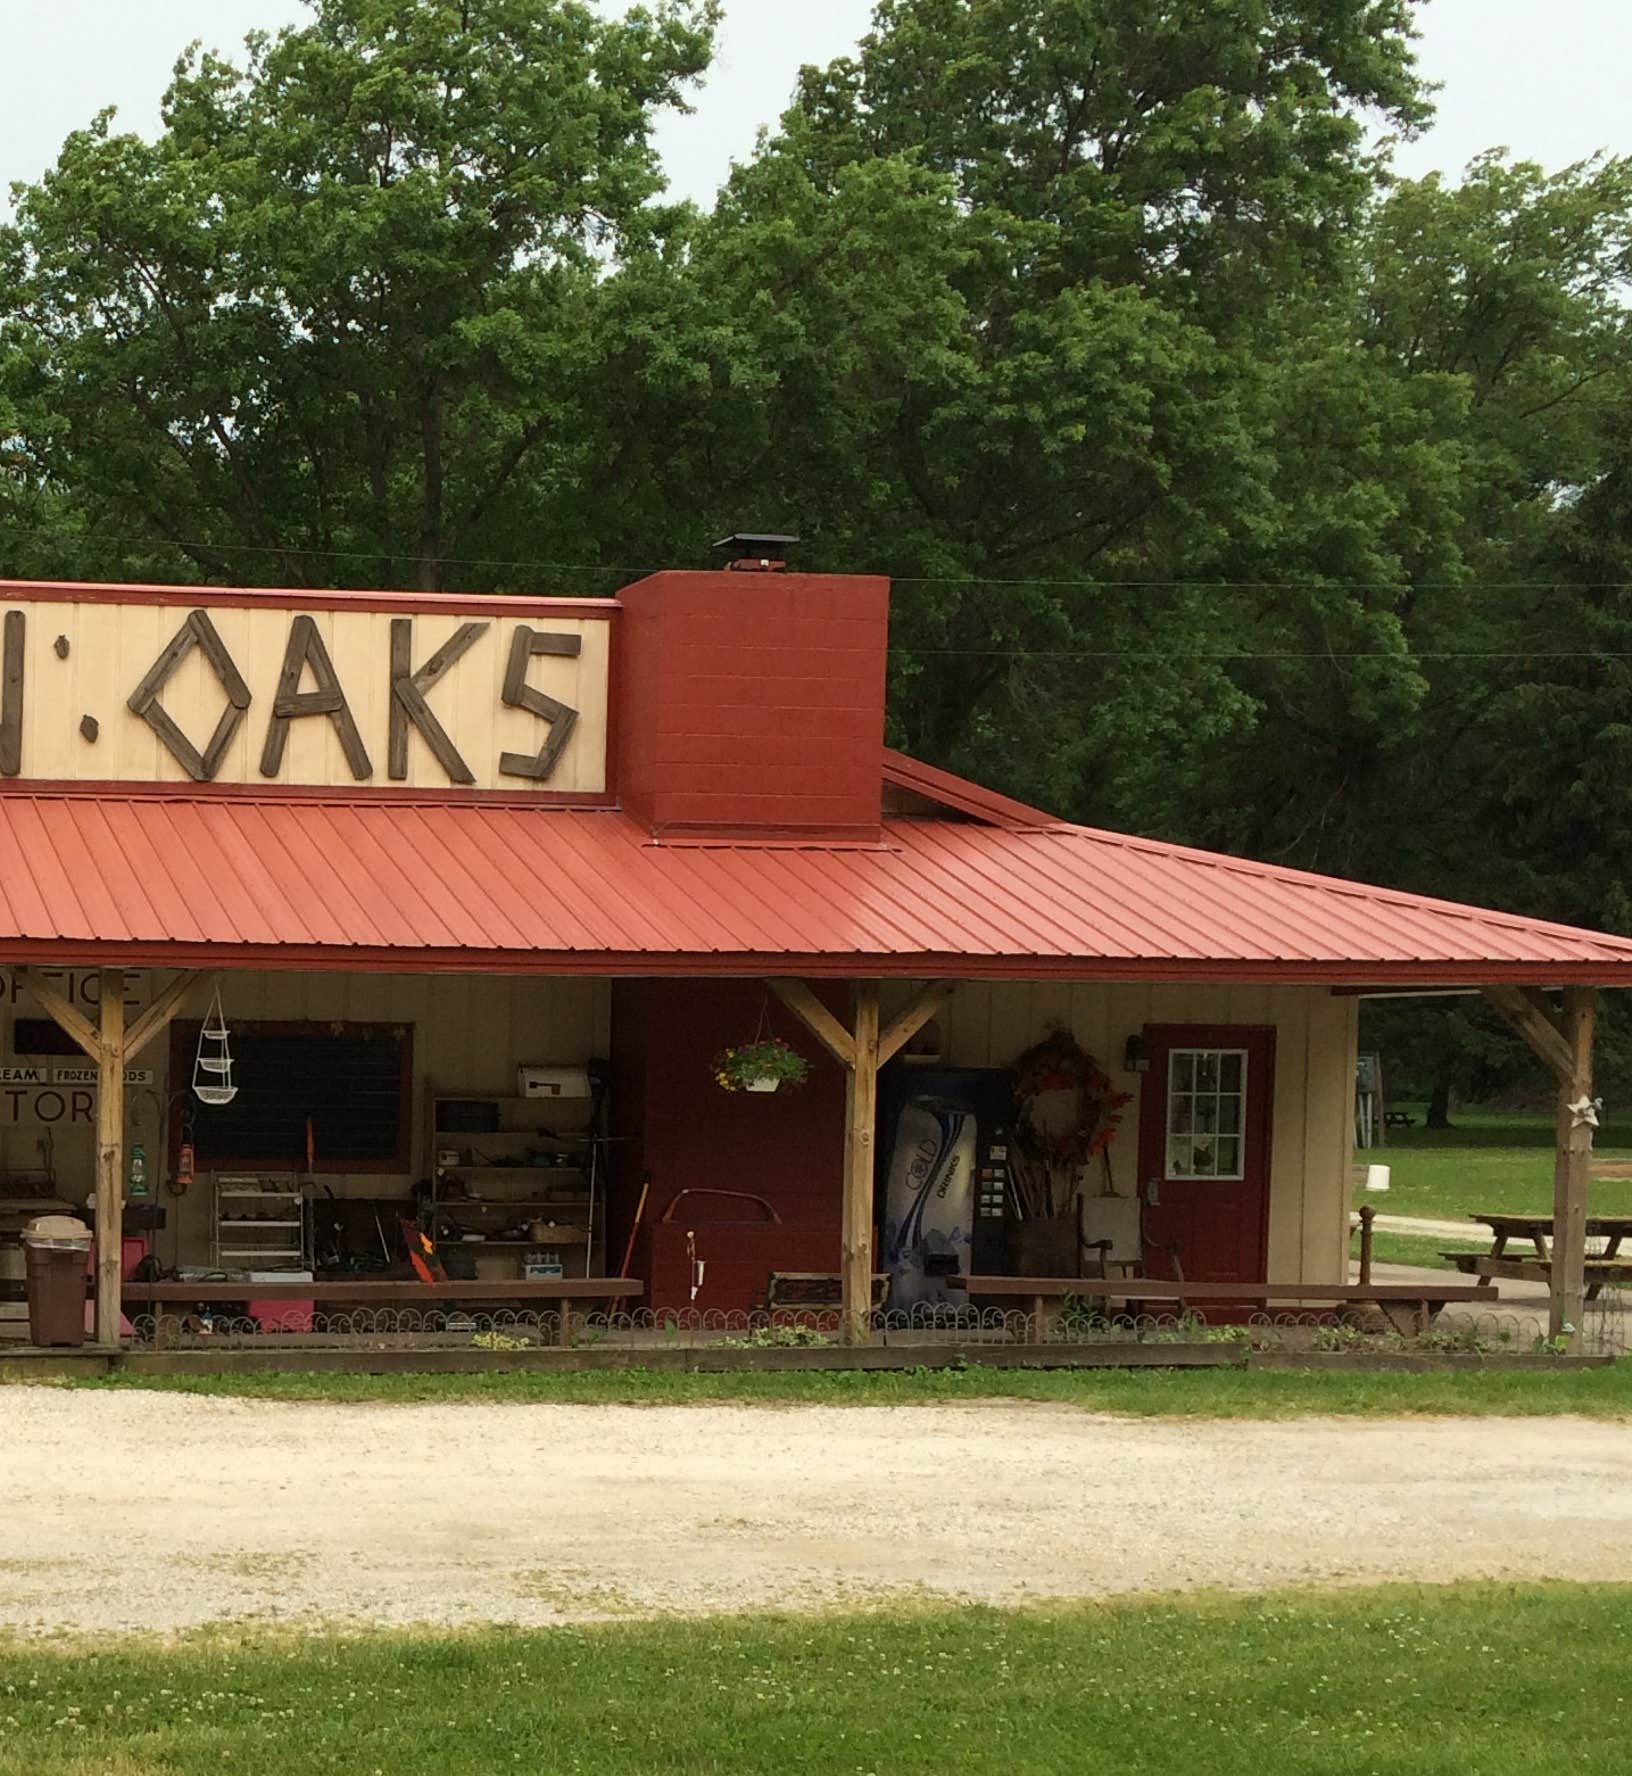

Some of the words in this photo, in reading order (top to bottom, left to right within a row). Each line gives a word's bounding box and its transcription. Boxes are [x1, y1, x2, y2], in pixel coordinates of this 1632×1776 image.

[127, 609, 582, 784] OAKS
[905, 1138, 938, 1191] COLD
[936, 1154, 961, 1199] DRINKS
